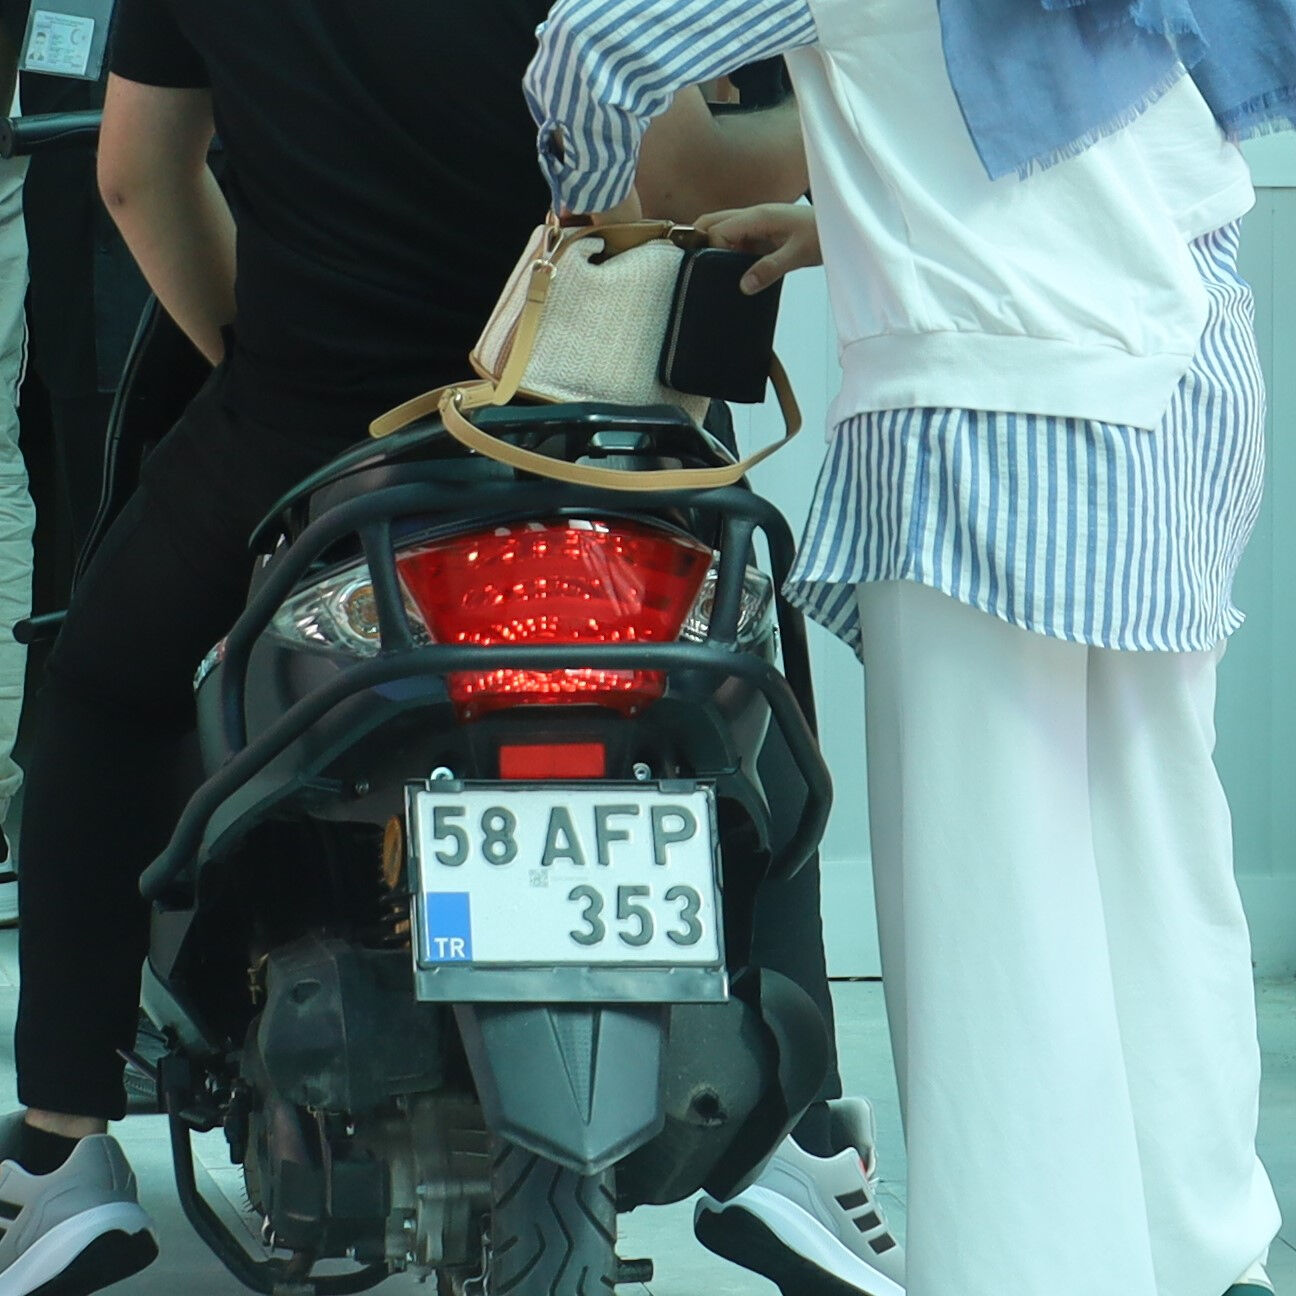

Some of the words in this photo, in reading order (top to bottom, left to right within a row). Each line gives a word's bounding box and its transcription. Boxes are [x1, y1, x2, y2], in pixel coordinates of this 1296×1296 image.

[432, 805, 519, 867] 58
[541, 804, 698, 867] AFP
[568, 884, 704, 947] 353
[434, 937, 466, 959] TR
